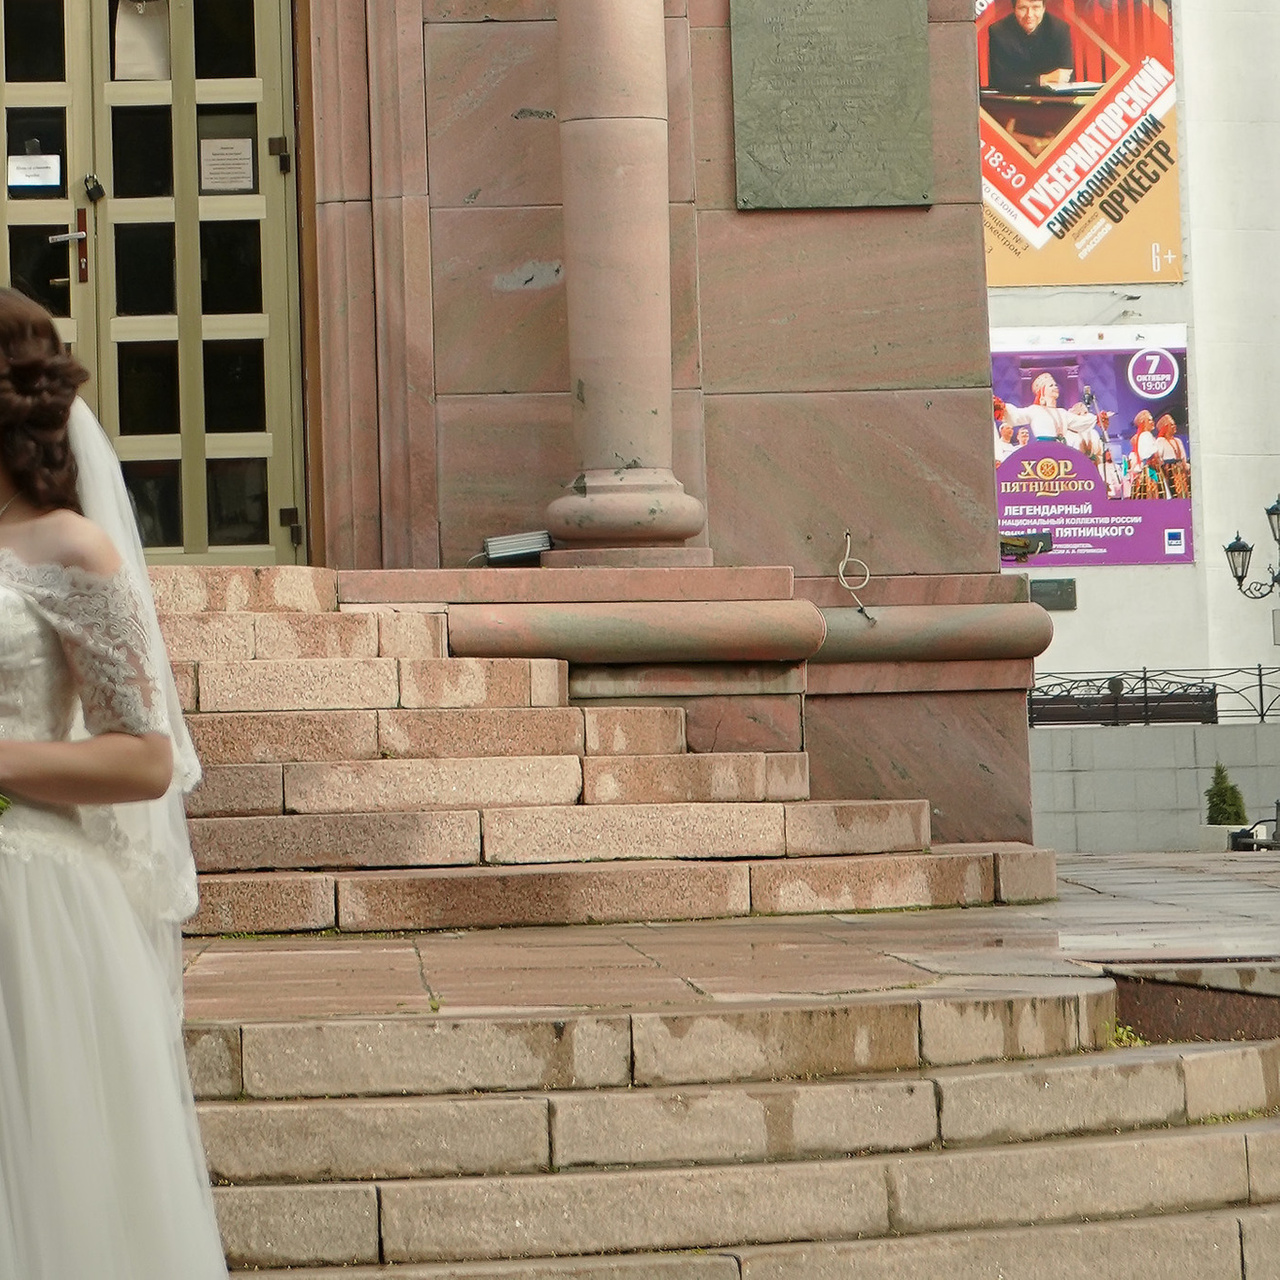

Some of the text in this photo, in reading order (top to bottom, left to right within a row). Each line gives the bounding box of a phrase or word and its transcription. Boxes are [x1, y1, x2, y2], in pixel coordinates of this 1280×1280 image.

[1020, 56, 1174, 222] ГУБЕРНАТОРСКИЙ
[984, 145, 1026, 189] 18:30
[1046, 111, 1166, 240] СИМФОНИЧЕСКИЙ
[1099, 140, 1175, 224] ОРКЕСТР
[1145, 355, 1160, 374] 7
[1142, 381, 1167, 391] 19:00
[1017, 457, 1077, 481] ХОР
[1000, 479, 1095, 497] ПЯТНИЦКОГО
[1004, 502, 1093, 517] ЛЕГЕНДАРНЫЙ
[1110, 516, 1142, 524] РОССИИ
[1055, 526, 1134, 538] ПЯТНИЦКОГО
